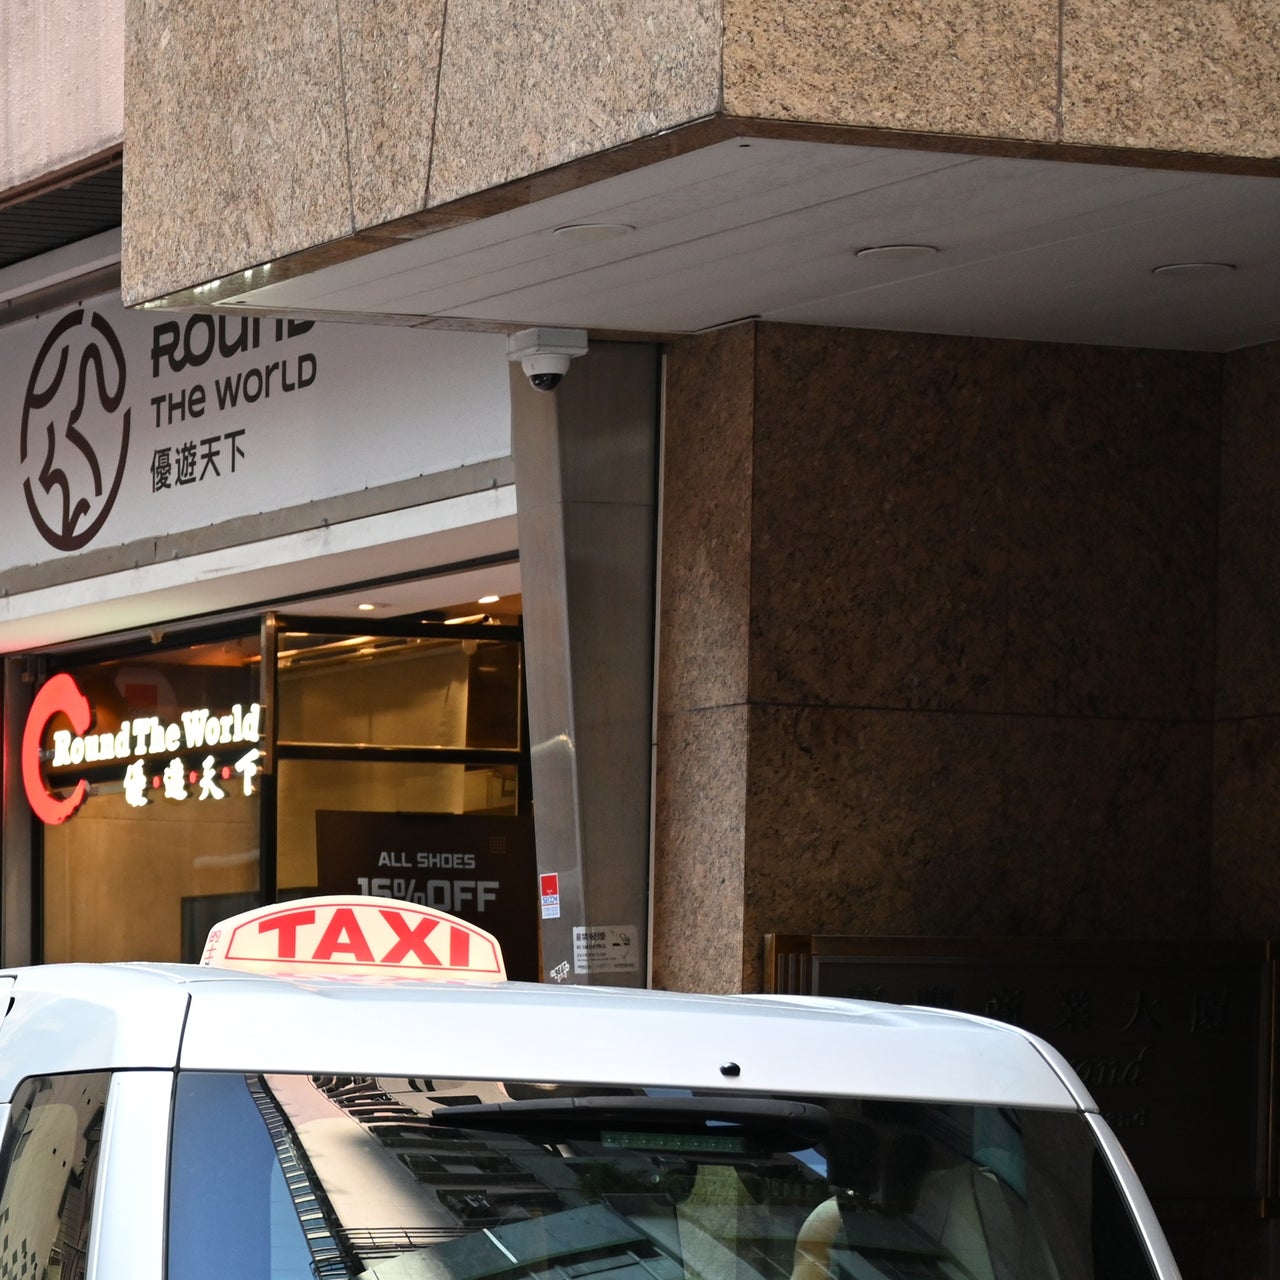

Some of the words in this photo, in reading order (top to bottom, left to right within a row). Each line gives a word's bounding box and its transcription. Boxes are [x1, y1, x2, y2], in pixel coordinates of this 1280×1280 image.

[150, 428, 246, 493] 優遊天下
[52, 720, 131, 768] Round
[132, 715, 181, 756] The
[181, 702, 261, 749] World
[378, 851, 413, 868] ALL
[416, 852, 476, 869] SHOES
[258, 907, 471, 968] TAXI
